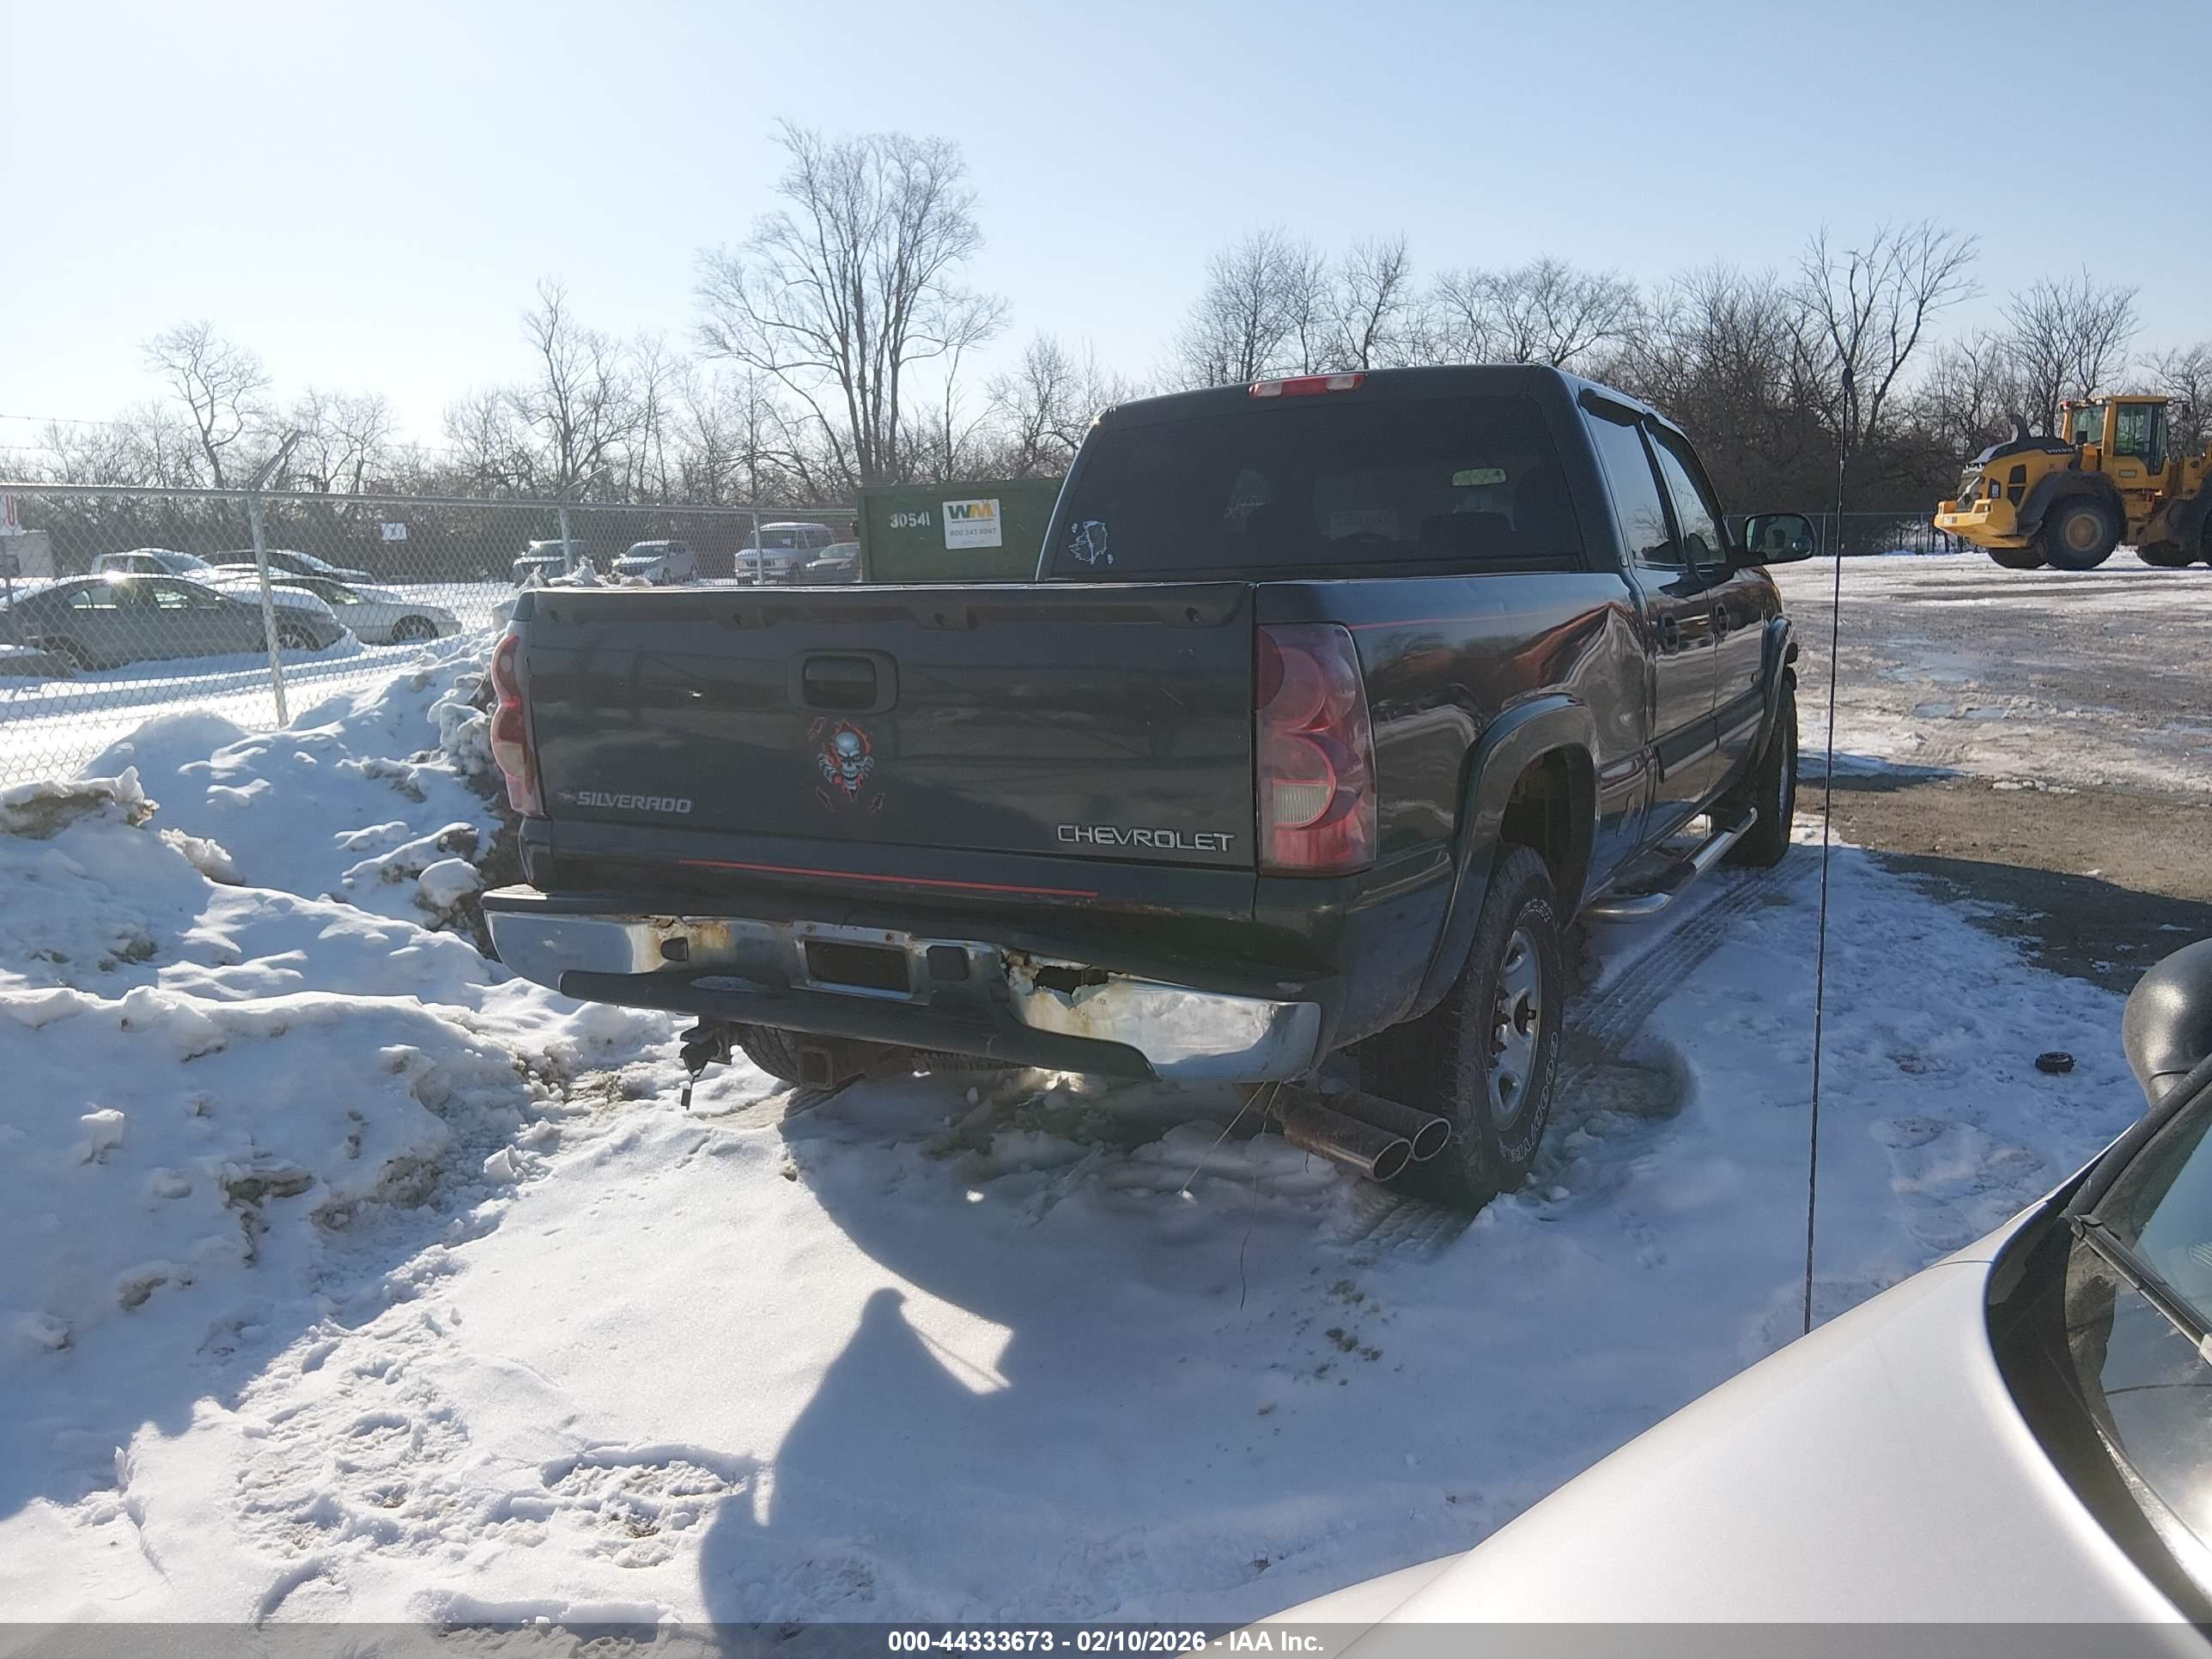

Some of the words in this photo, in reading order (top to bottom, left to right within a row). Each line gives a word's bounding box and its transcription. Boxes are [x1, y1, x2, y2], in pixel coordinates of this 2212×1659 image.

[890, 511, 931, 529] 30541
[948, 503, 995, 520] WM
[577, 791, 693, 814] SILVERADO
[1057, 823, 1237, 853] CHEVROLET
